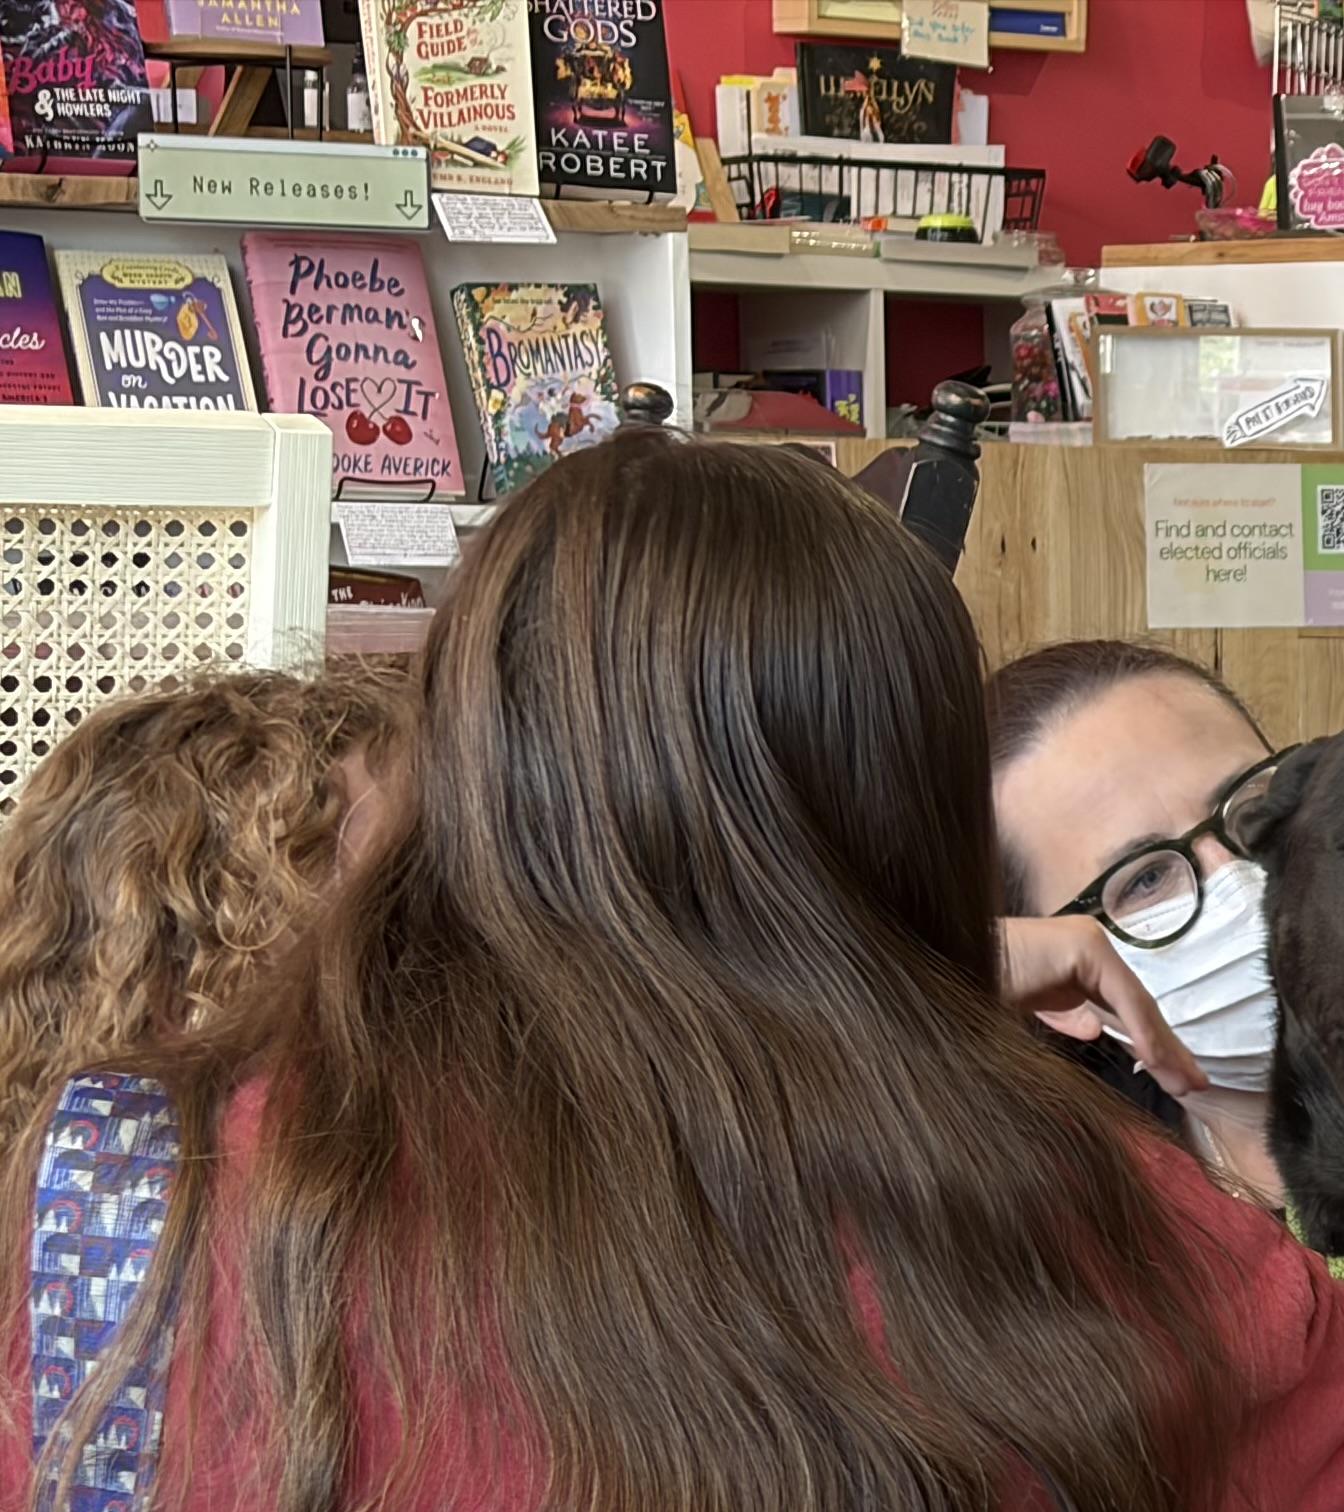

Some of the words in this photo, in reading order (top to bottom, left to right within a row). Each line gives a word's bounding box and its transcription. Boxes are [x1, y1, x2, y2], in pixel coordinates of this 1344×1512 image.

[221, 12, 280, 28] ALLEN
[417, 18, 464, 42] FIELD
[543, 15, 638, 48] GODS
[416, 40, 469, 61] GUIDE
[10, 47, 97, 94] Baby
[34, 89, 55, 121] &
[55, 88, 76, 102] THE
[77, 89, 106, 104] LATE
[108, 89, 142, 104] NIGHT
[56, 101, 113, 118] HOWLERS
[420, 83, 509, 109] FORMERLY
[416, 102, 517, 131] VILLAINOUS
[551, 127, 651, 155] KATEE
[539, 153, 668, 183] ROBERT
[192, 175, 232, 195] New
[249, 176, 371, 203] Releases!
[289, 254, 406, 297] Phoebe
[282, 297, 427, 344] Berman's
[99, 329, 231, 385] MURDER
[305, 334, 418, 382] Gonna
[486, 327, 605, 392] BROMANTASY
[121, 373, 148, 390] on
[298, 377, 361, 416] LOSE
[395, 378, 440, 421] IT
[381, 454, 452, 478] AVERICK
[1154, 520, 1193, 538] Find
[1194, 520, 1227, 539] and
[1230, 521, 1295, 539] contact
[1159, 540, 1223, 561] elected
[1226, 541, 1289, 561] officials
[1205, 564, 1248, 583] here!
